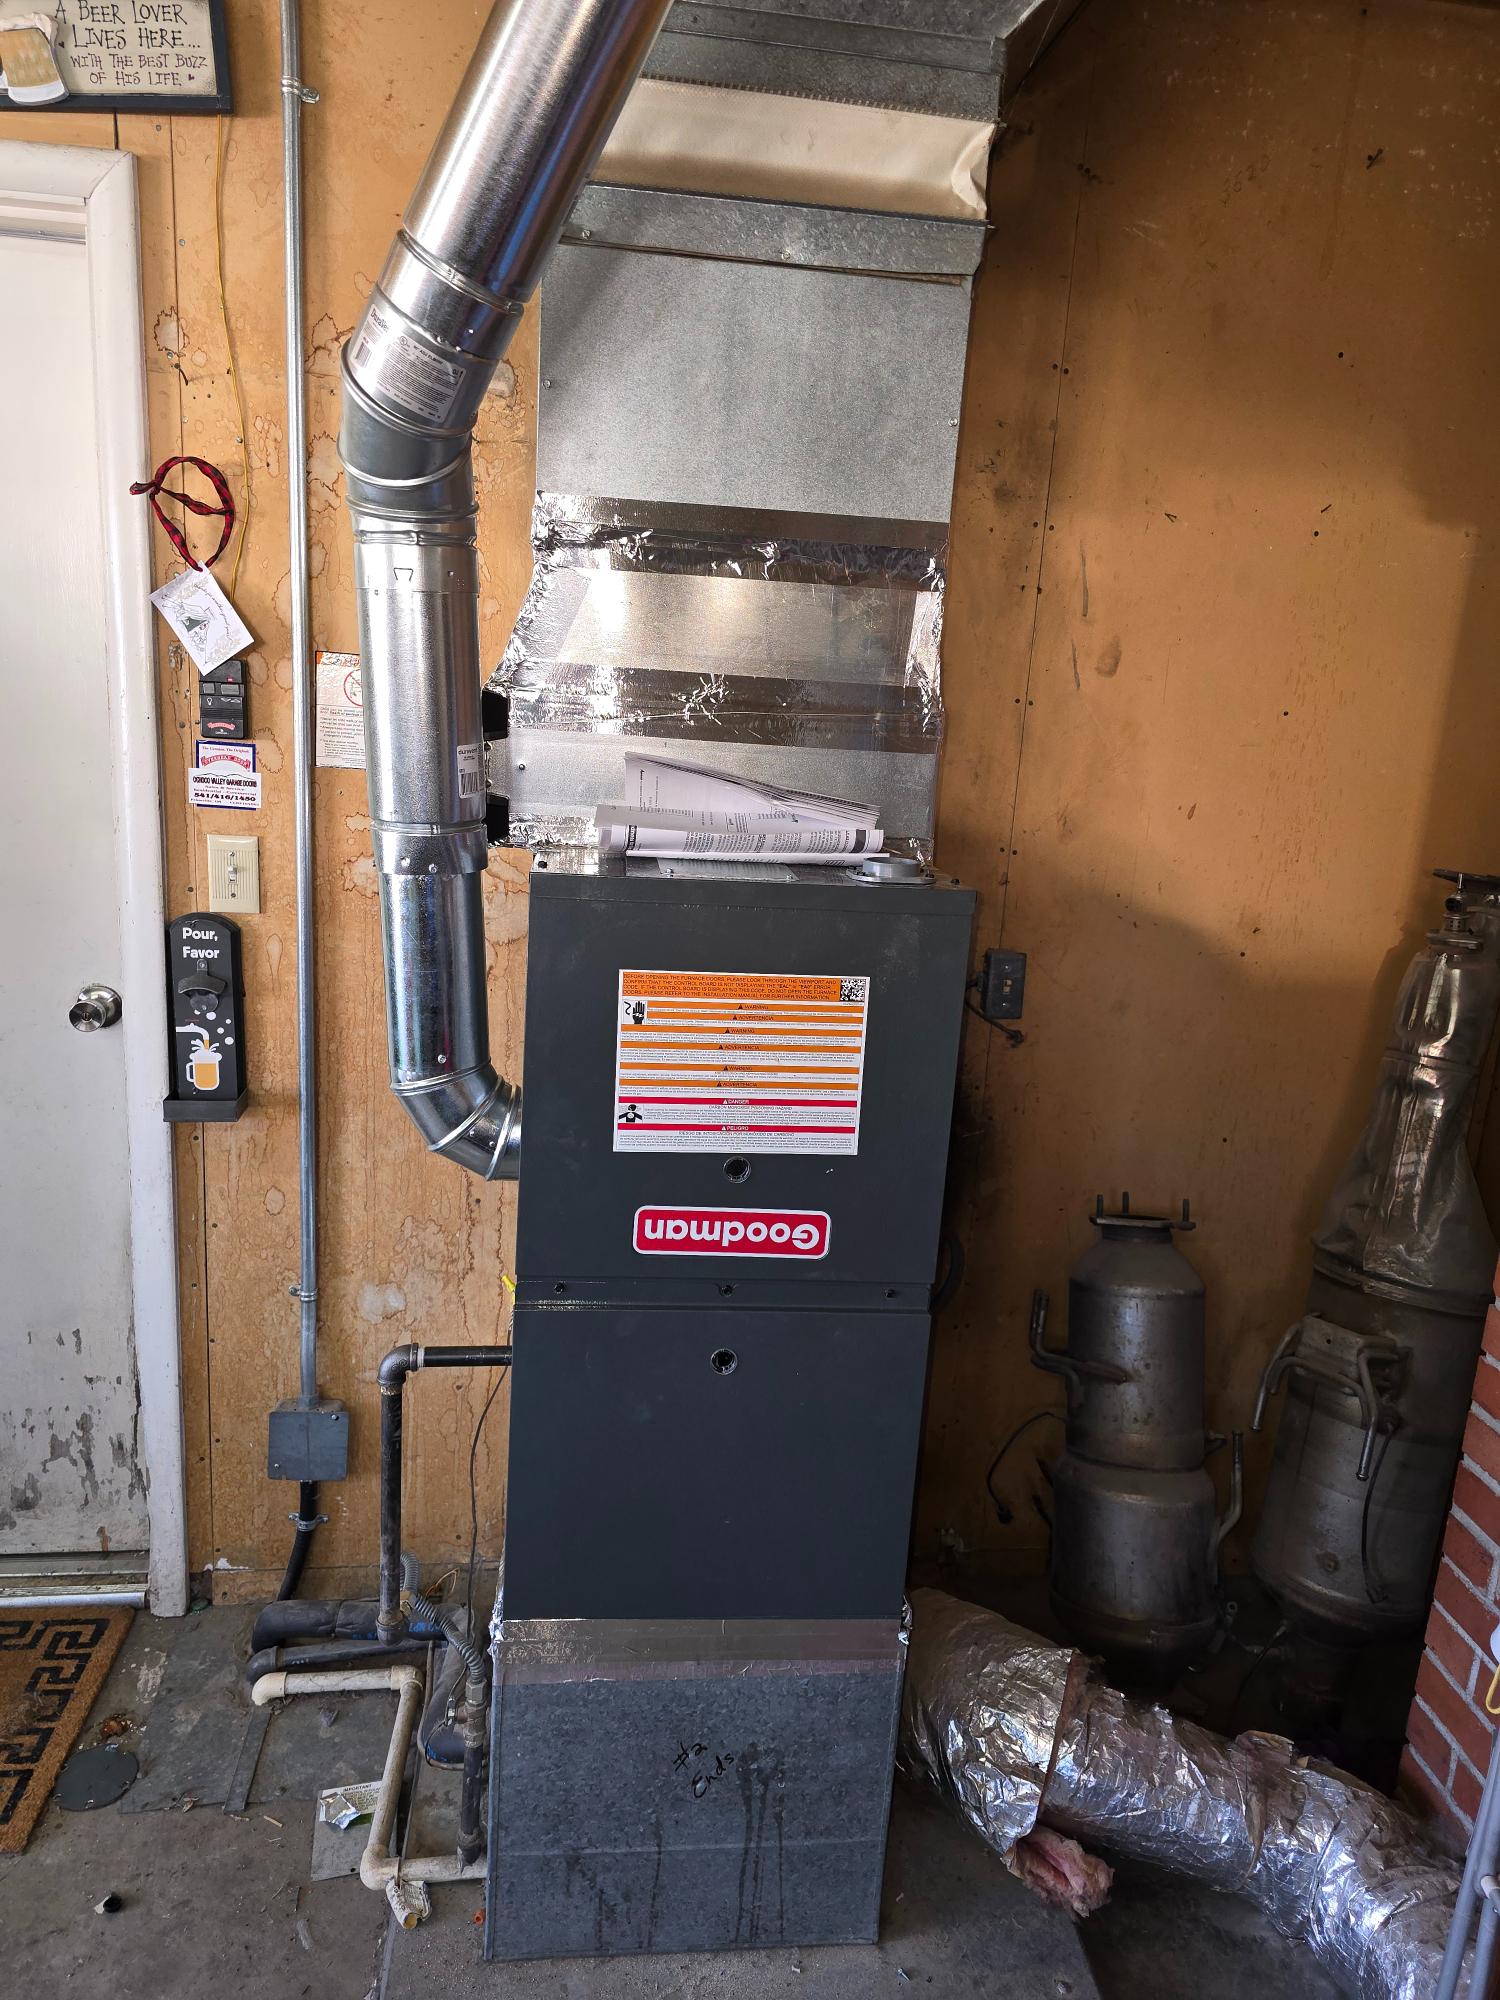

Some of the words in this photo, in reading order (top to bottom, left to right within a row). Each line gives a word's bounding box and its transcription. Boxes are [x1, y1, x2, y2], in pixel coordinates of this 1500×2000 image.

[55, 0, 67, 24] A
[78, 0, 125, 24] BEER
[132, 0, 187, 25] LOVER
[72, 24, 126, 50] LIVES
[138, 28, 201, 49] HERE...
[70, 54, 102, 70] WITH
[109, 53, 133, 68] THE
[138, 54, 170, 68] BEST
[176, 54, 208, 68] BUZZ
[90, 72, 106, 84] OF
[115, 71, 140, 86] HIS
[148, 72, 182, 86] LIFE
[182, 927, 218, 942] Pour,
[182, 946, 220, 959] Favor
[644, 1218, 820, 1250] Goodman
[672, 1741, 708, 1772] #2
